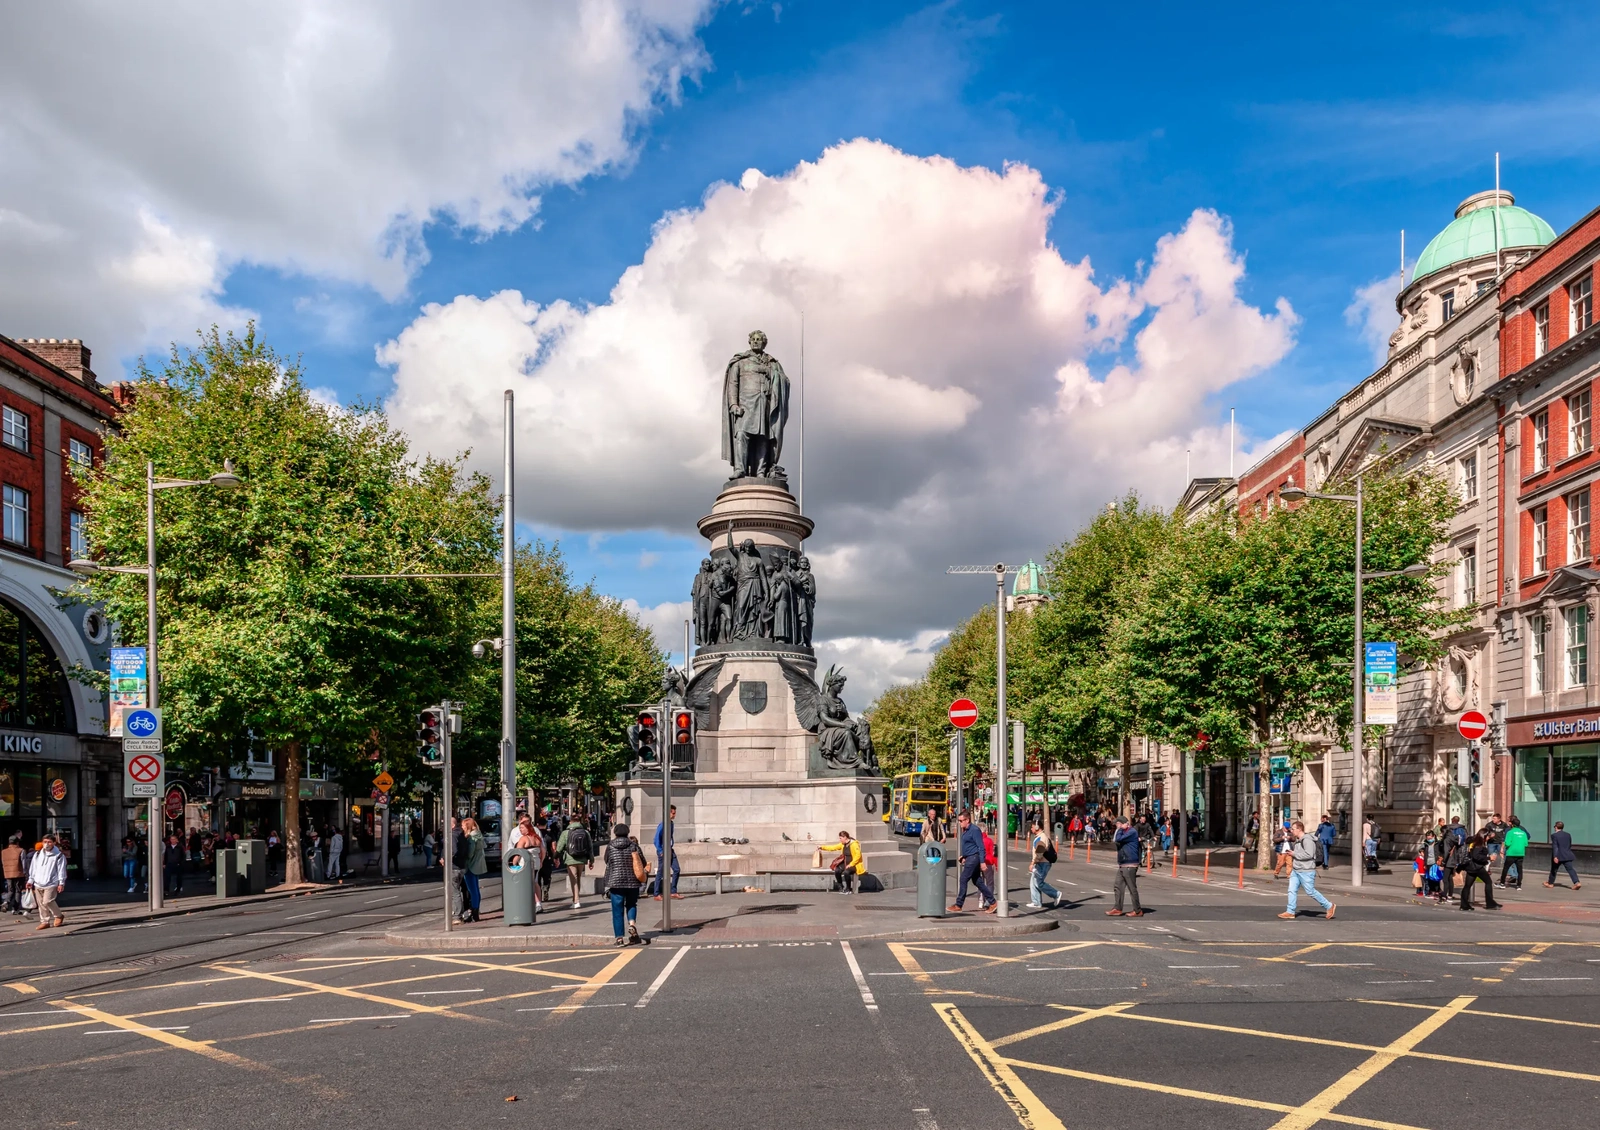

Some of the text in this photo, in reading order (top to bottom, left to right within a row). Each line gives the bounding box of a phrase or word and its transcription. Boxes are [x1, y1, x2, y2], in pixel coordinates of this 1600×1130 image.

[1544, 721, 1575, 736] Ulster
[4, 735, 42, 753] KING
[242, 786, 273, 795] McDonald's
